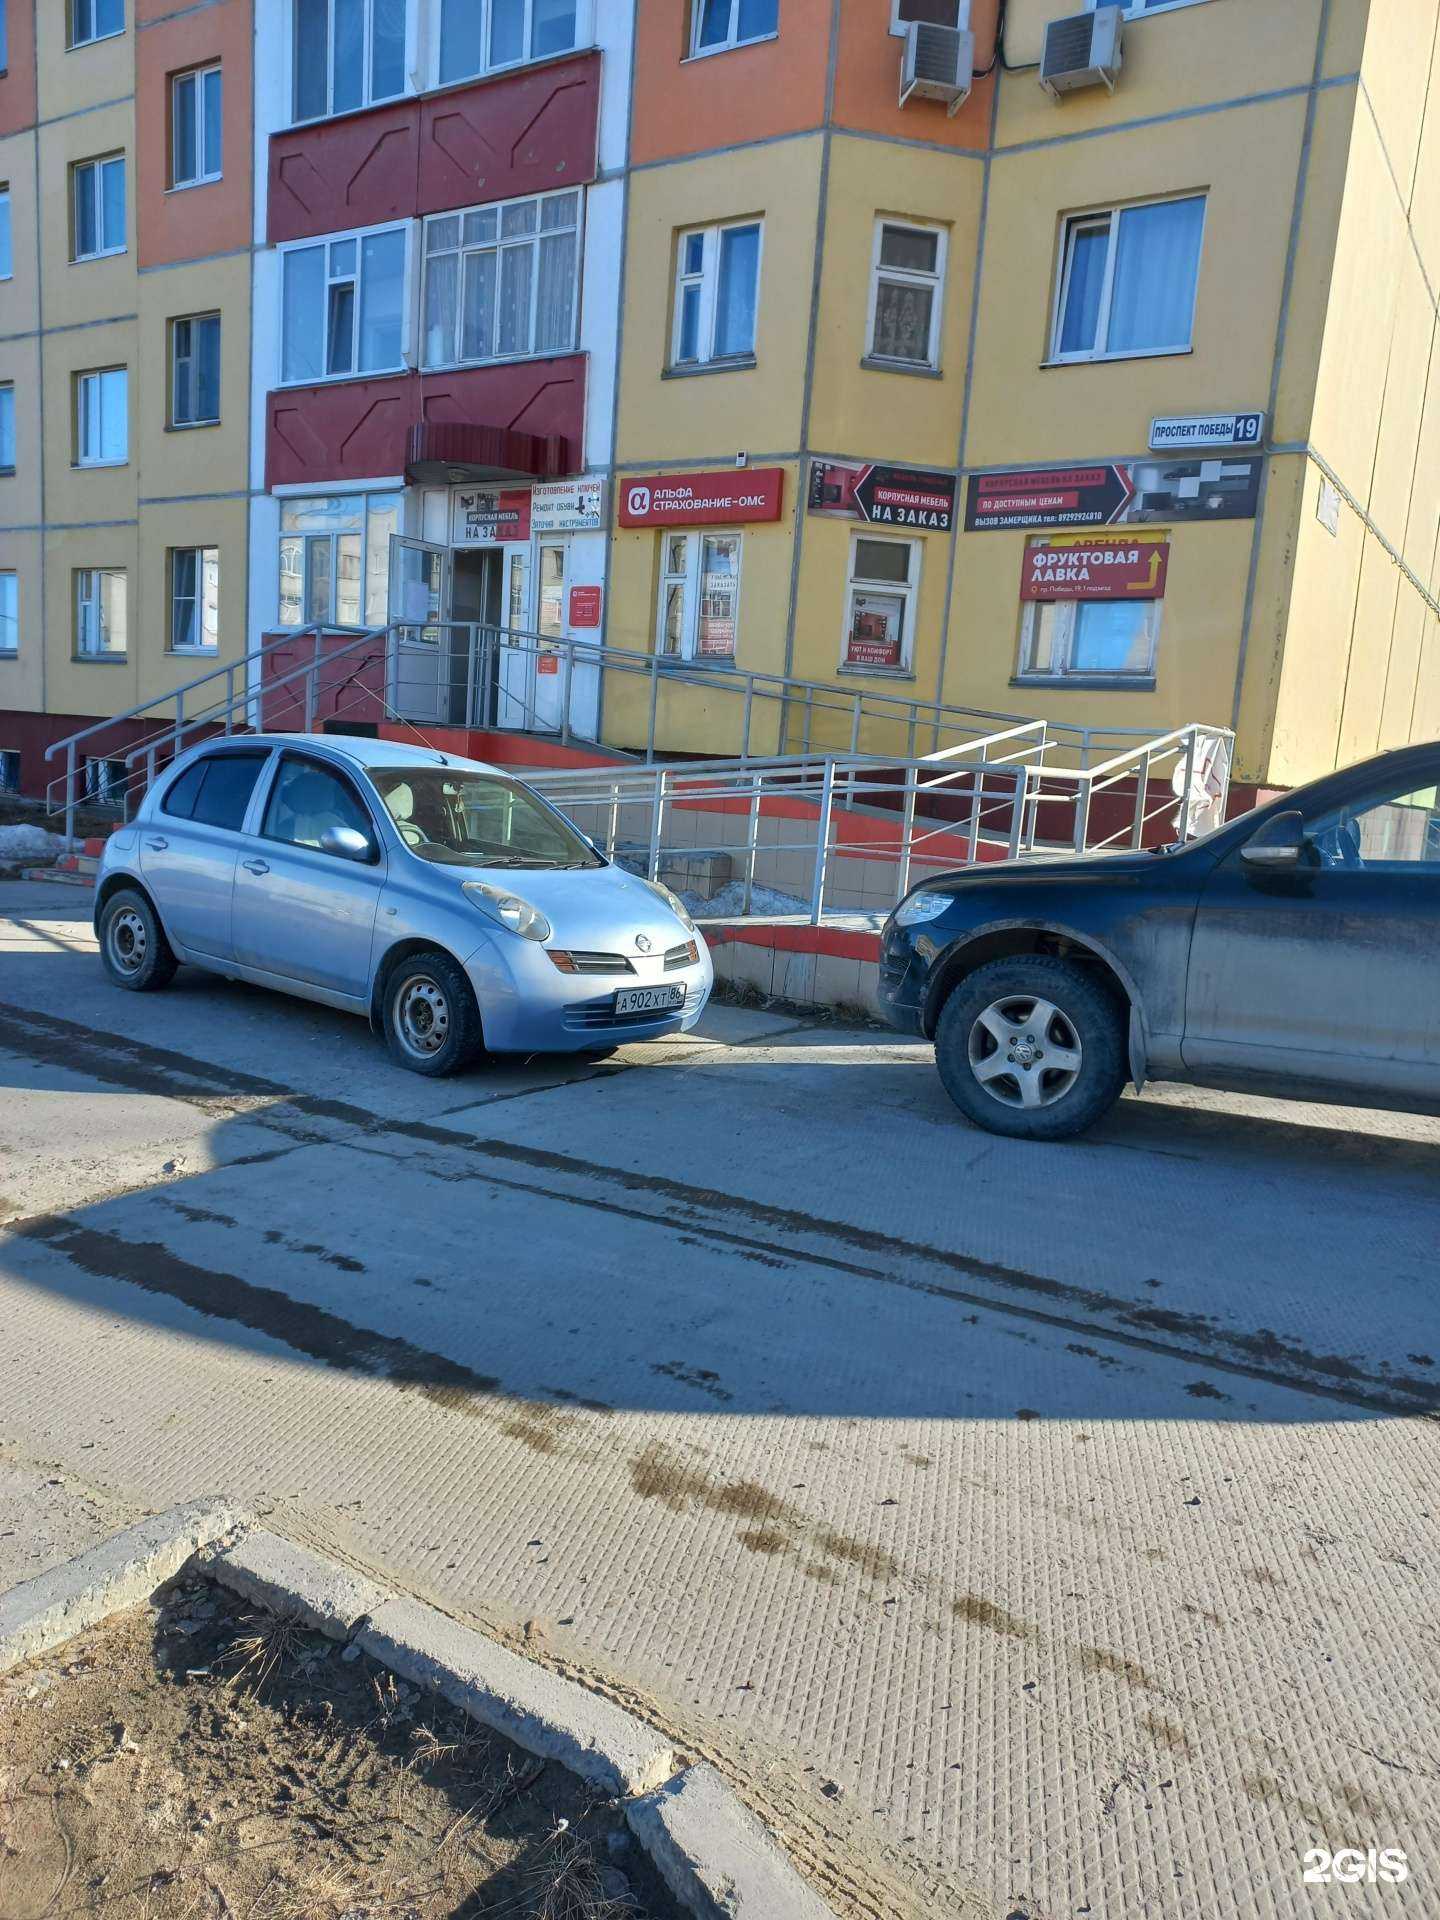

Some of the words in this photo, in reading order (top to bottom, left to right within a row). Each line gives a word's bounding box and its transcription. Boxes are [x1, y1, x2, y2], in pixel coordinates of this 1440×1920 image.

[1155, 425, 1197, 437] ПРОСПЕКТ
[1198, 422, 1233, 436] ПОБЕДЫ
[1236, 418, 1257, 438] 19
[653, 487, 693, 499] АЛЬФА
[878, 490, 919, 504] КОРПУСНАЯ
[920, 496, 949, 508] МЕБЕЛЬ
[653, 495, 766, 511] СТРАХОВАНИЕ-ОМС
[982, 500, 992, 509] ПО
[993, 498, 1037, 509] ДОСТУПНЫМ
[1039, 496, 1063, 506] ЦЕНАМ
[468, 513, 497, 521] КОРПУСНАЯ
[872, 504, 892, 520] НА
[897, 507, 949, 527] ЗАКАЗ
[999, 514, 1042, 525] ЗАМЕРЩИКА
[465, 527, 479, 538] НА
[1032, 550, 1139, 567] ФРУКТОВАЯ
[1031, 567, 1090, 582] ЛАВКА
[670, 987, 681, 1000] 86
